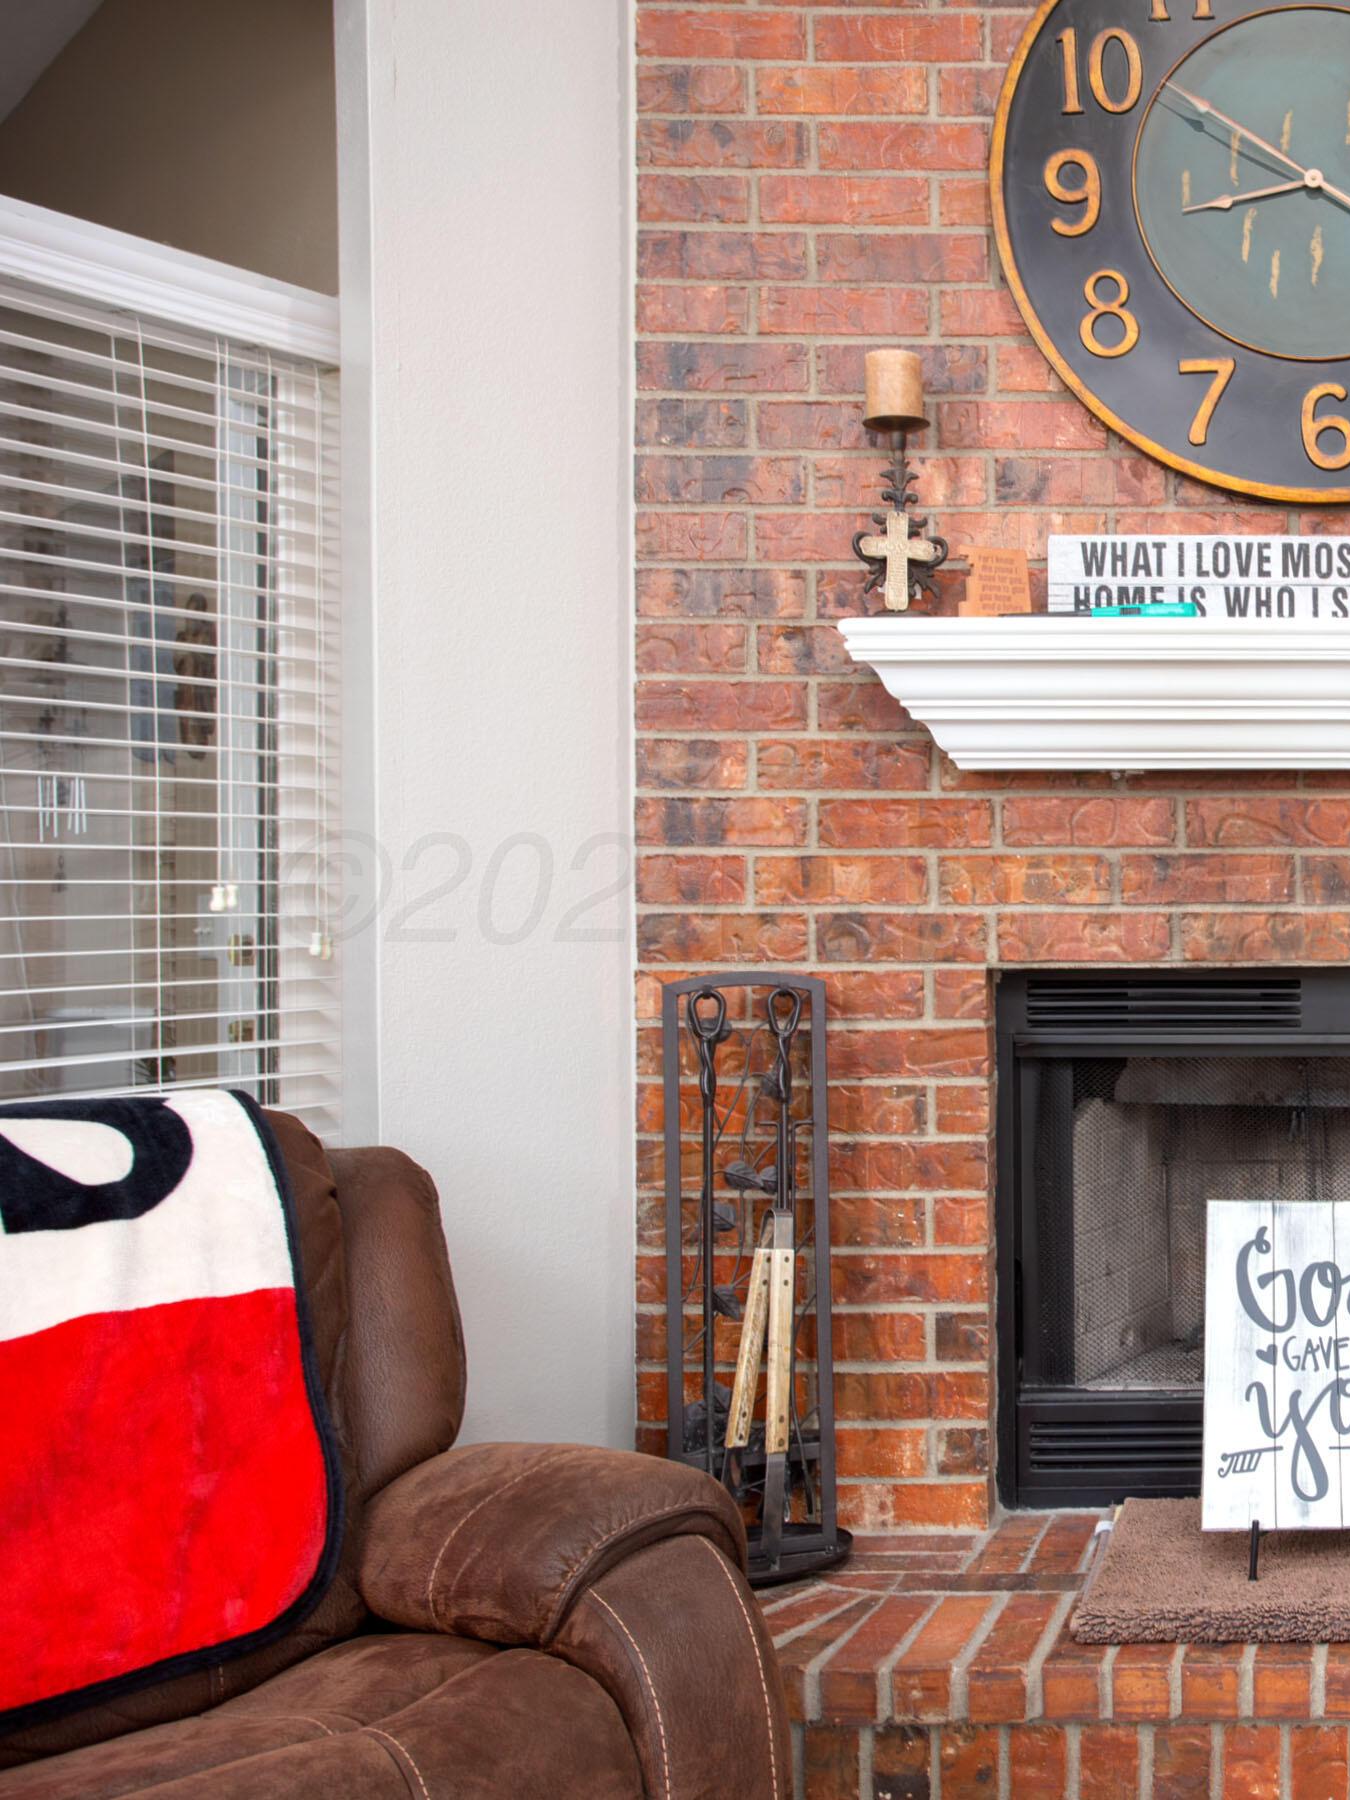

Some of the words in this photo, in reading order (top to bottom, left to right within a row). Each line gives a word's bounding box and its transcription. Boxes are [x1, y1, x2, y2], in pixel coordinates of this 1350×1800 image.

[1055, 27, 1143, 114] 10
[1043, 148, 1101, 237] 9
[1079, 268, 1140, 358] 8
[1178, 357, 1236, 446] 7
[1080, 541, 1167, 578] WHAT
[1178, 541, 1185, 578] I
[1196, 541, 1272, 579] LOVE
[1223, 586, 1295, 618] WHO
[1312, 587, 1319, 618] I
[1282, 1335, 1350, 1373] GAVE
